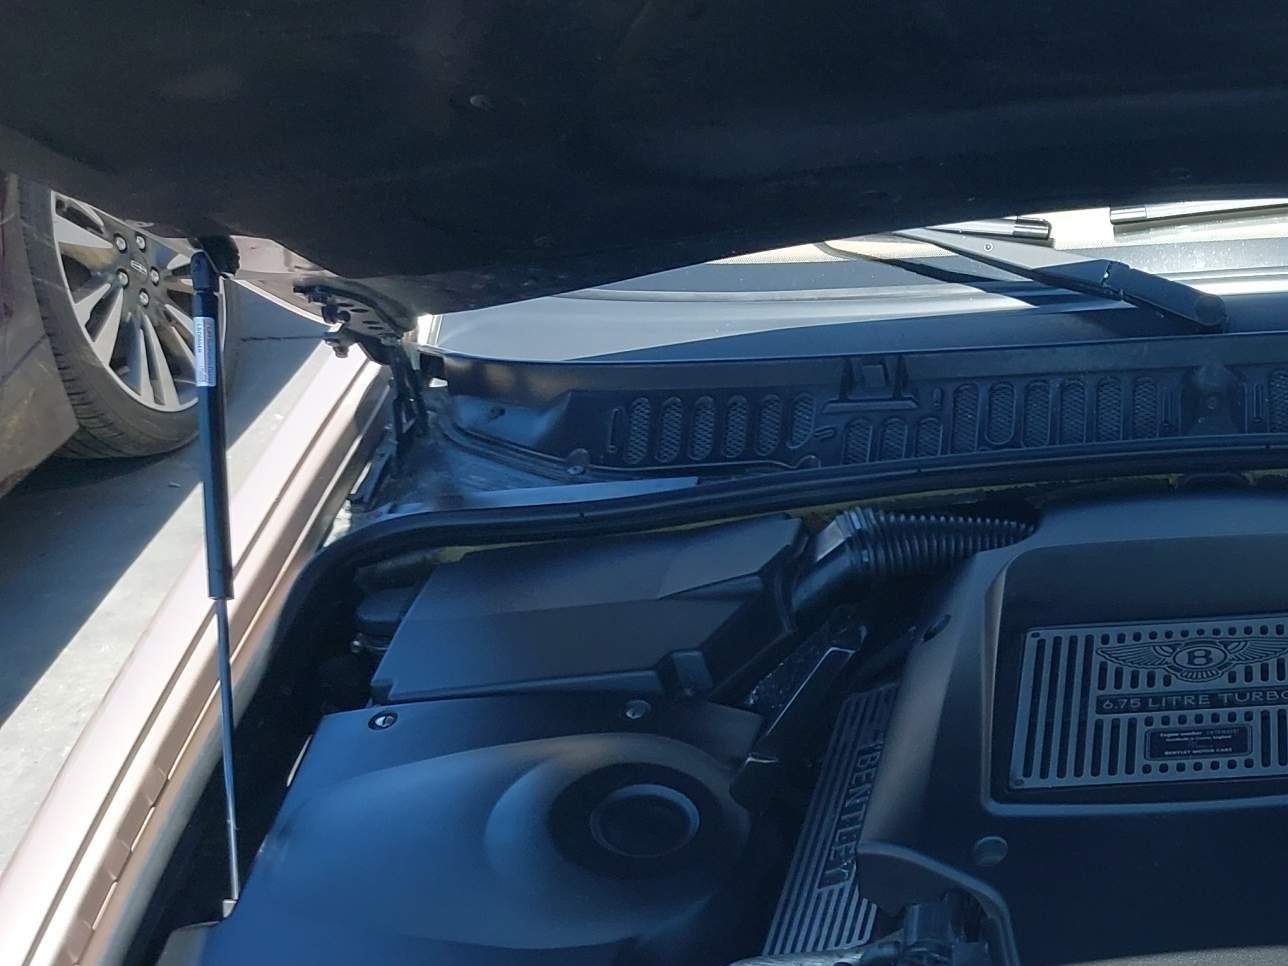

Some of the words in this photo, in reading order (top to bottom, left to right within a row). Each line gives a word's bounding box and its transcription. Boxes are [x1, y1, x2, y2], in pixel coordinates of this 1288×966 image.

[1186, 649, 1213, 666] B
[1103, 698, 1142, 711] 6.75
[1148, 694, 1211, 709] LITRE
[824, 743, 883, 880] BENTLEY
